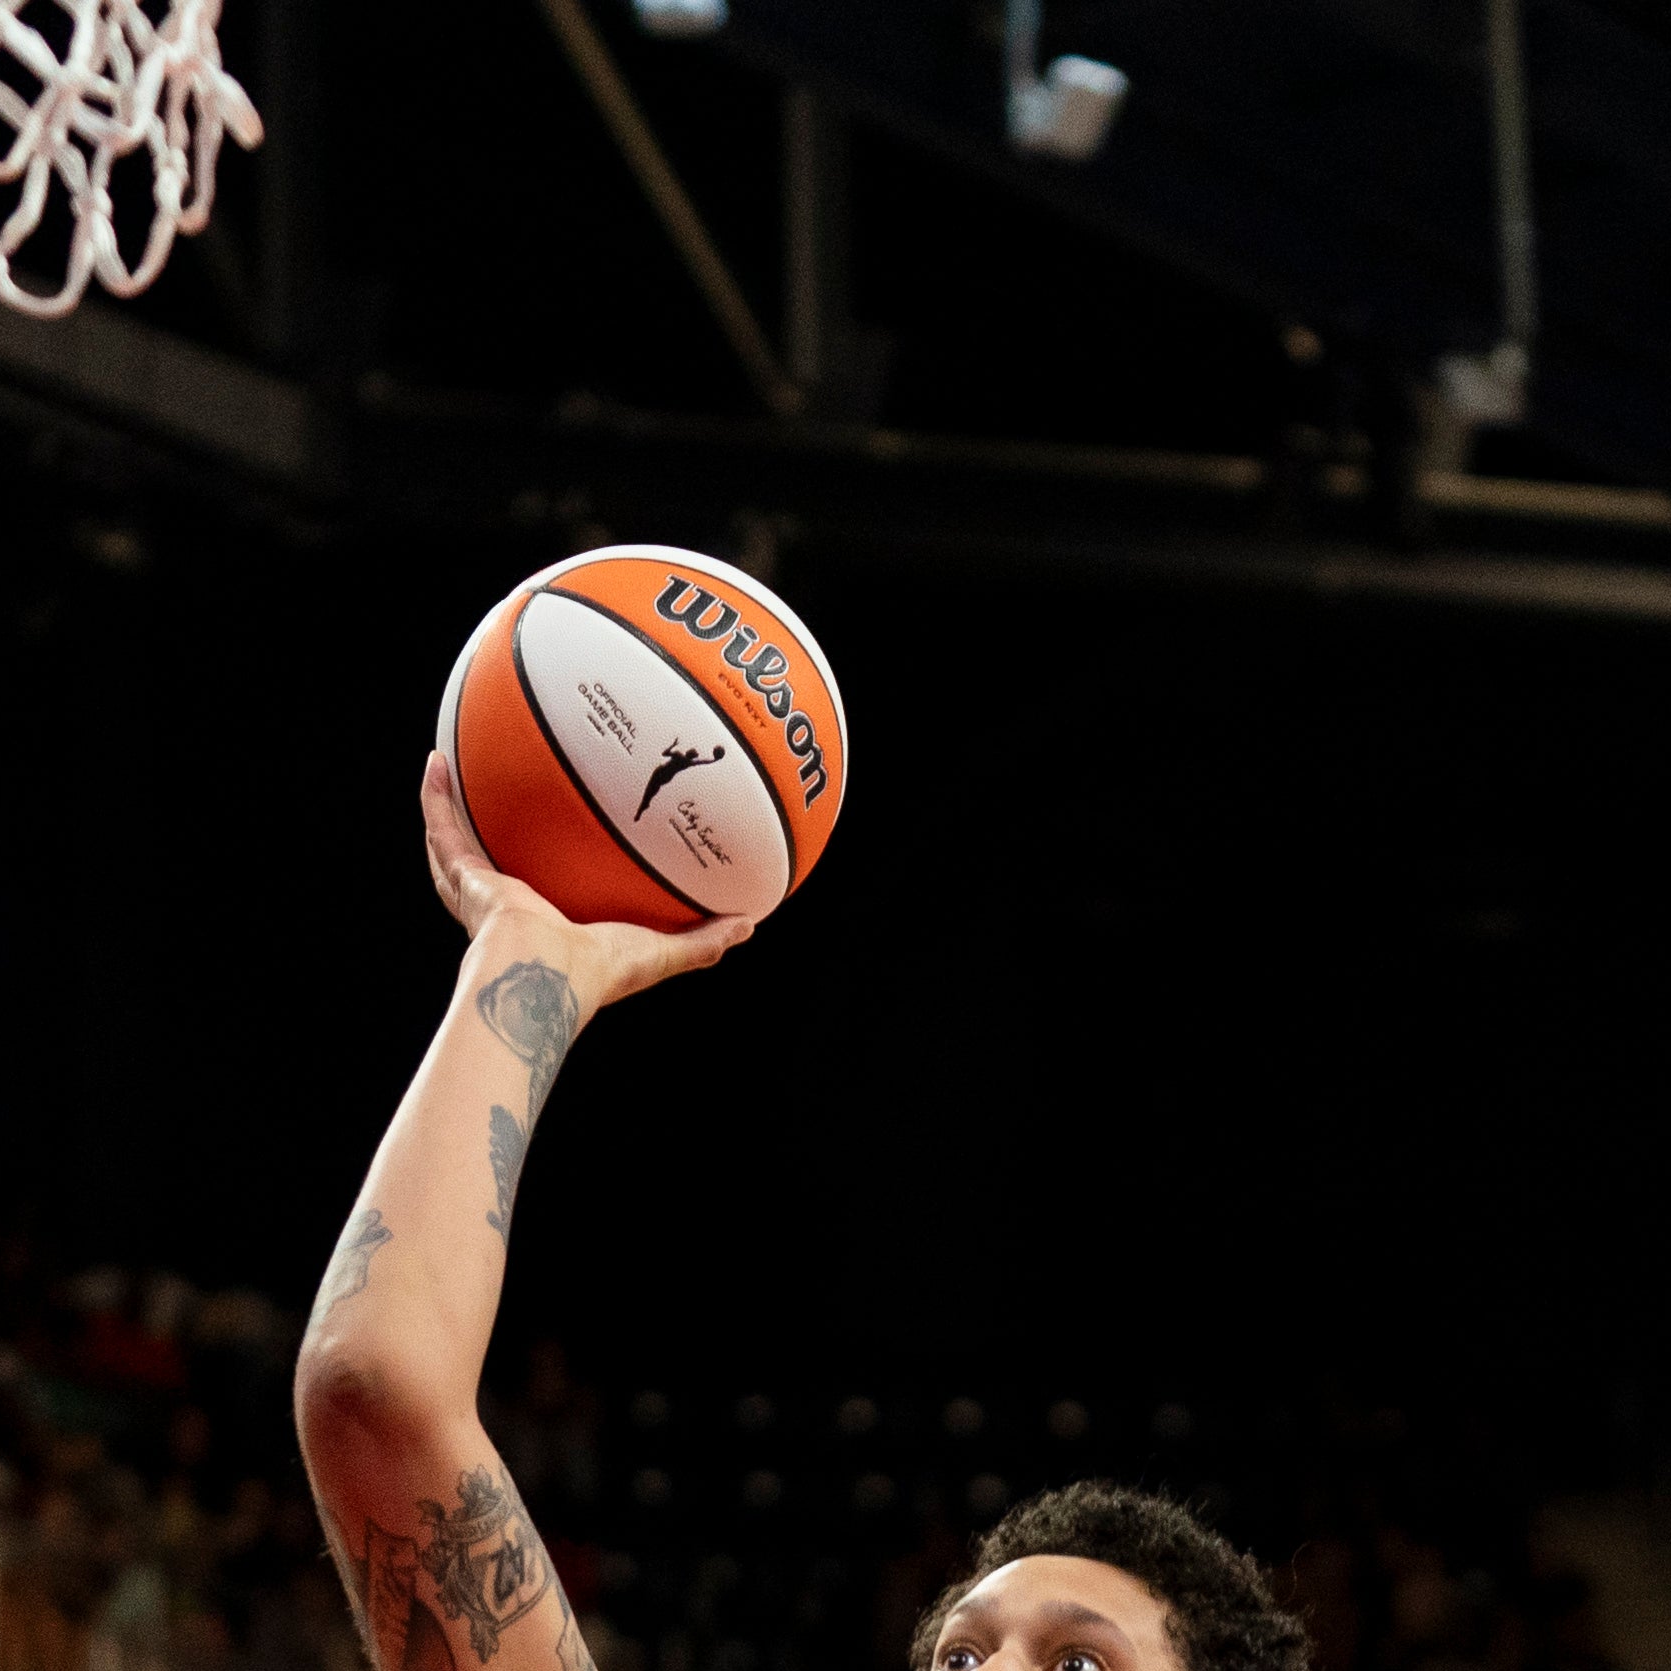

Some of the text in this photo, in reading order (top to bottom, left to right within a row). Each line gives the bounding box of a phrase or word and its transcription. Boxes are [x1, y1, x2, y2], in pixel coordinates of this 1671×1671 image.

[577, 683, 610, 721] GAME
[607, 720, 633, 757] BALL
[593, 683, 636, 740] OFFICIAL
[654, 573, 828, 813] Wilson
